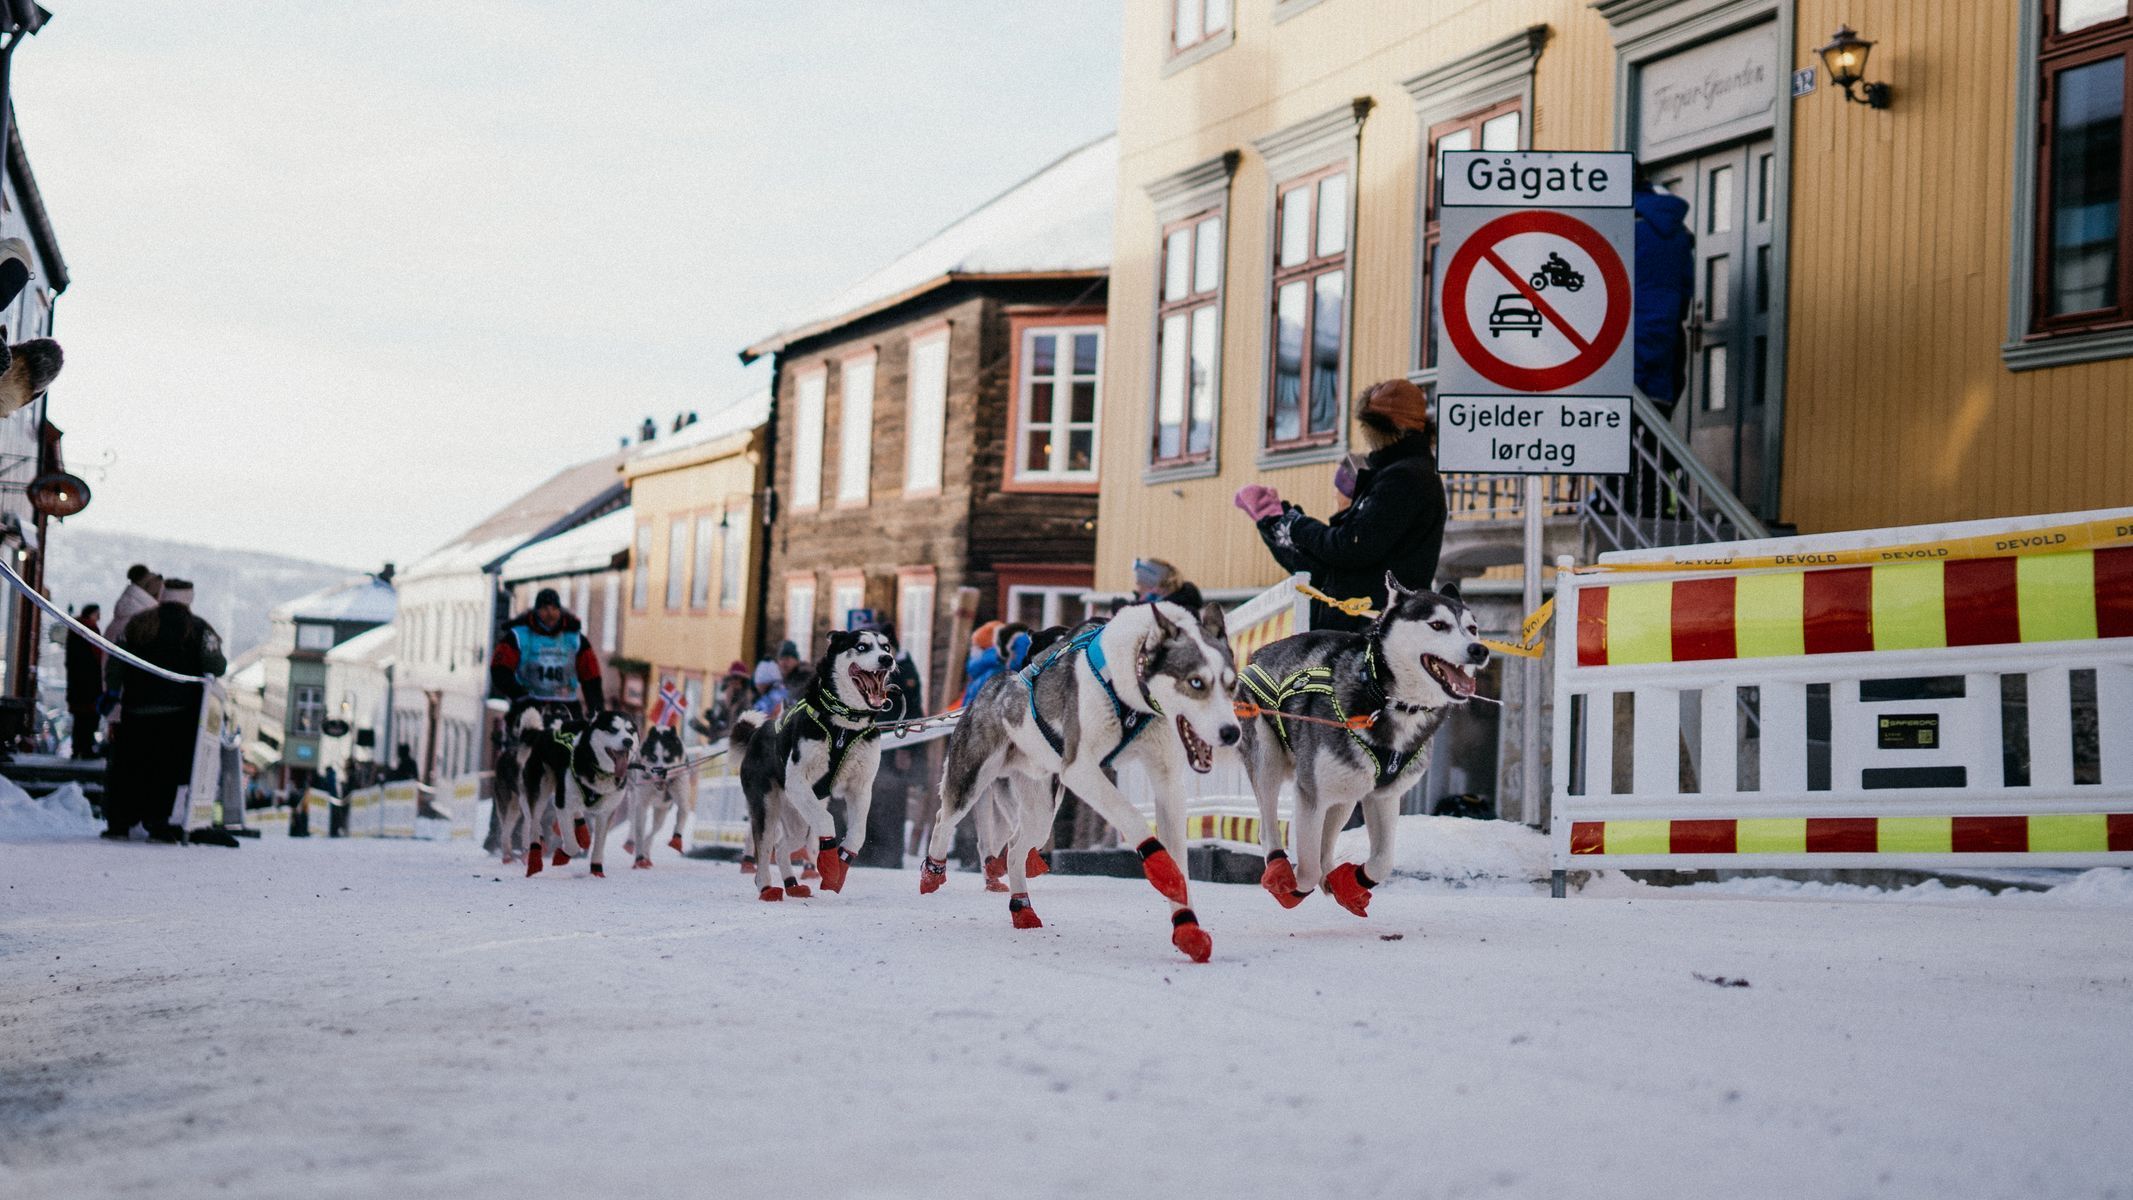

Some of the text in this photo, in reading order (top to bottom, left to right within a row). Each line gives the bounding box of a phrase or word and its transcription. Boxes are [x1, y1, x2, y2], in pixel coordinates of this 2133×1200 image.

[1467, 157, 1609, 199] Gågate
[1449, 404, 1621, 433] Gjelder bare
[1491, 438, 1576, 467] lørdag
[1775, 554, 1837, 565] DEVOLD
[1881, 548, 1949, 561] DEVOLD
[1995, 533, 2067, 552] DEVOLD
